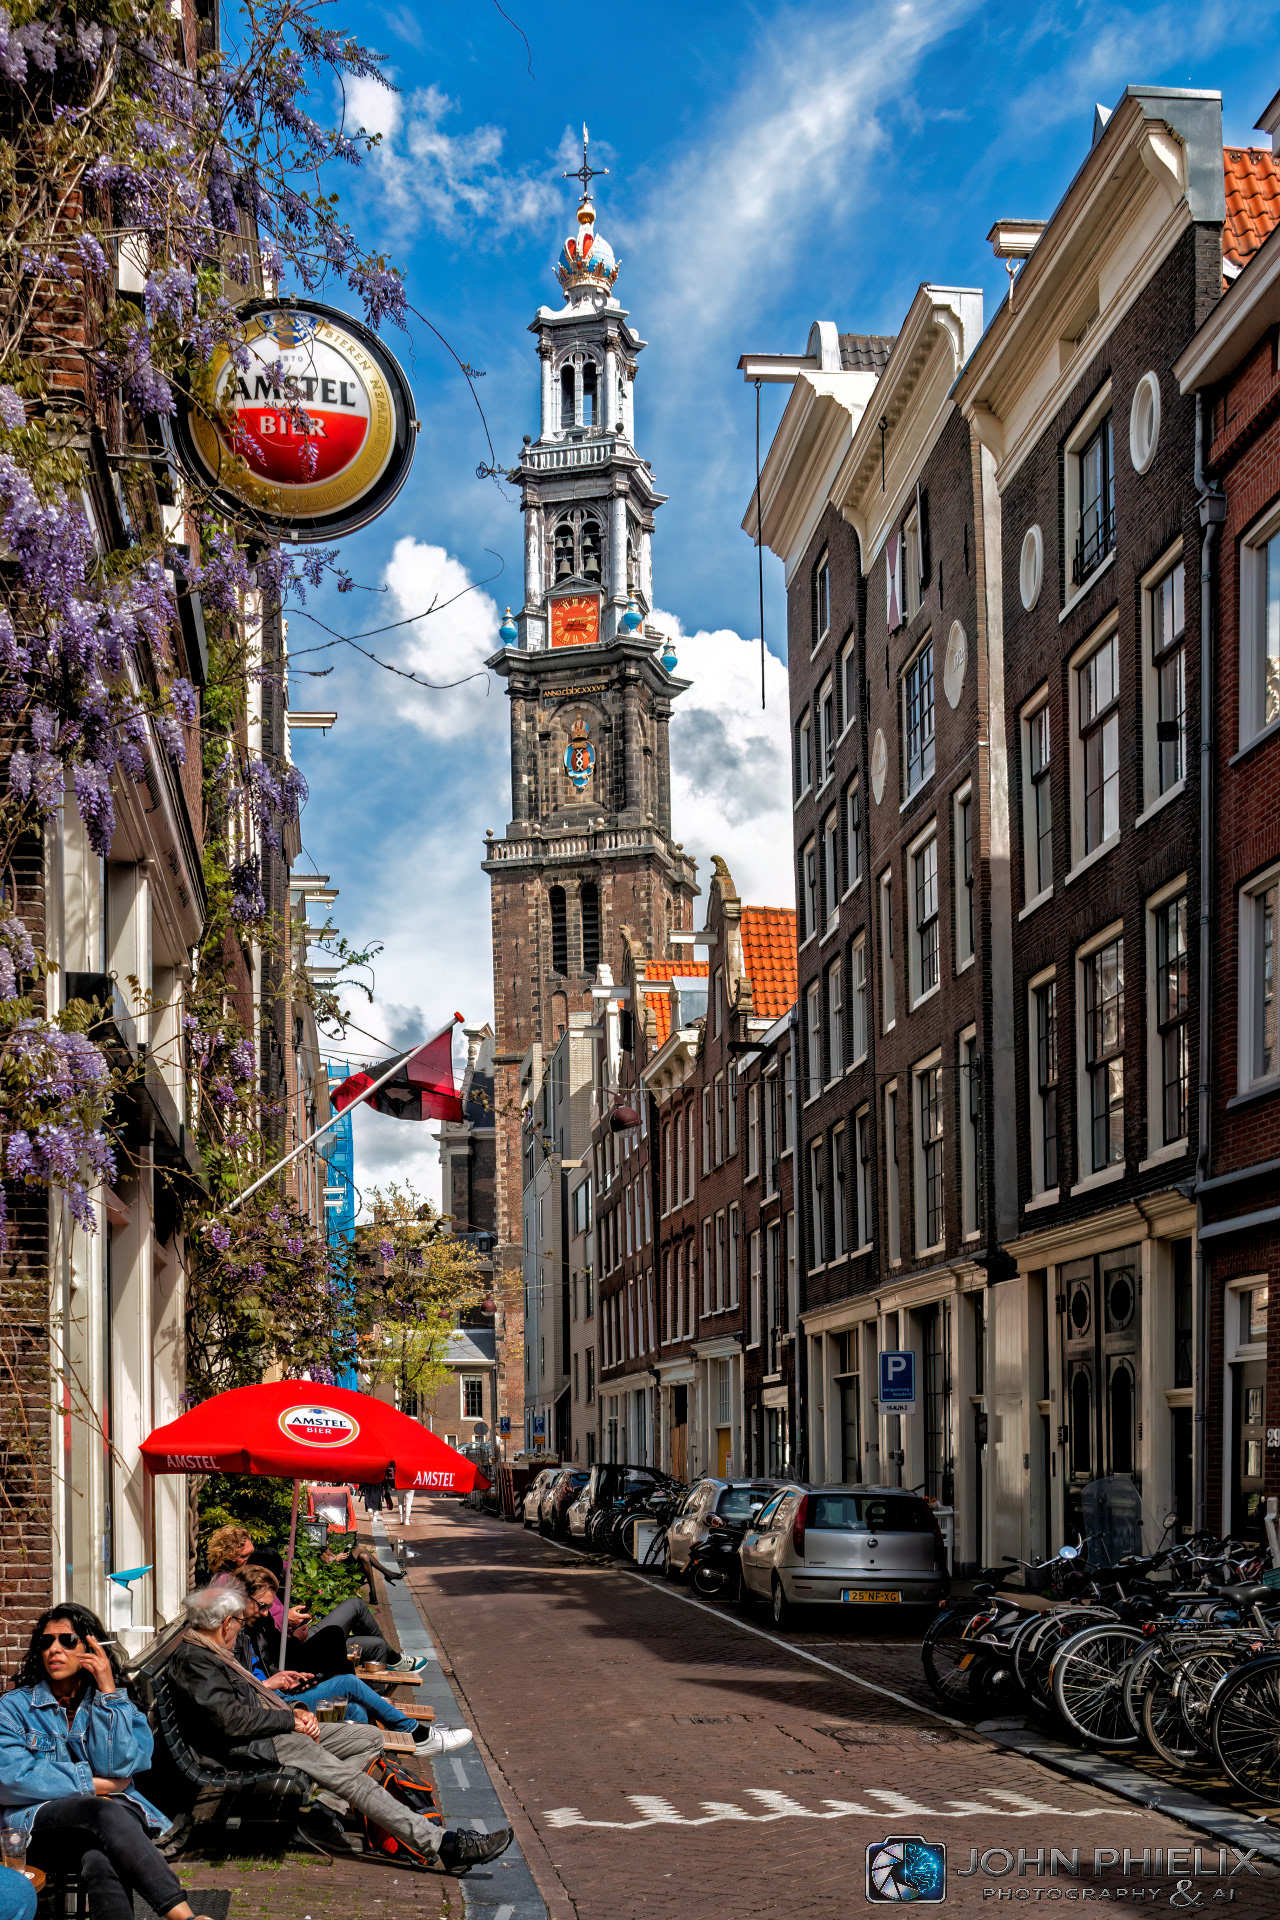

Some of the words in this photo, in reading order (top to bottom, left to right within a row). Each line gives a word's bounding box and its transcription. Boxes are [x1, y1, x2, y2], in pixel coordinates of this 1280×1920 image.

[324, 329, 371, 371] BIEREN
[297, 475, 361, 507] TRADITIE
[361, 379, 389, 475] GEBROUWEN
[887, 1356, 907, 1381] P
[292, 1416, 347, 1427] AMSTEL
[502, 1418, 509, 1426] P
[536, 1418, 543, 1427] P
[307, 1427, 332, 1435] BIER
[1267, 1428, 1280, 1448] 29
[167, 1454, 221, 1469] AMSTEL
[412, 1470, 454, 1487] AMSTEL
